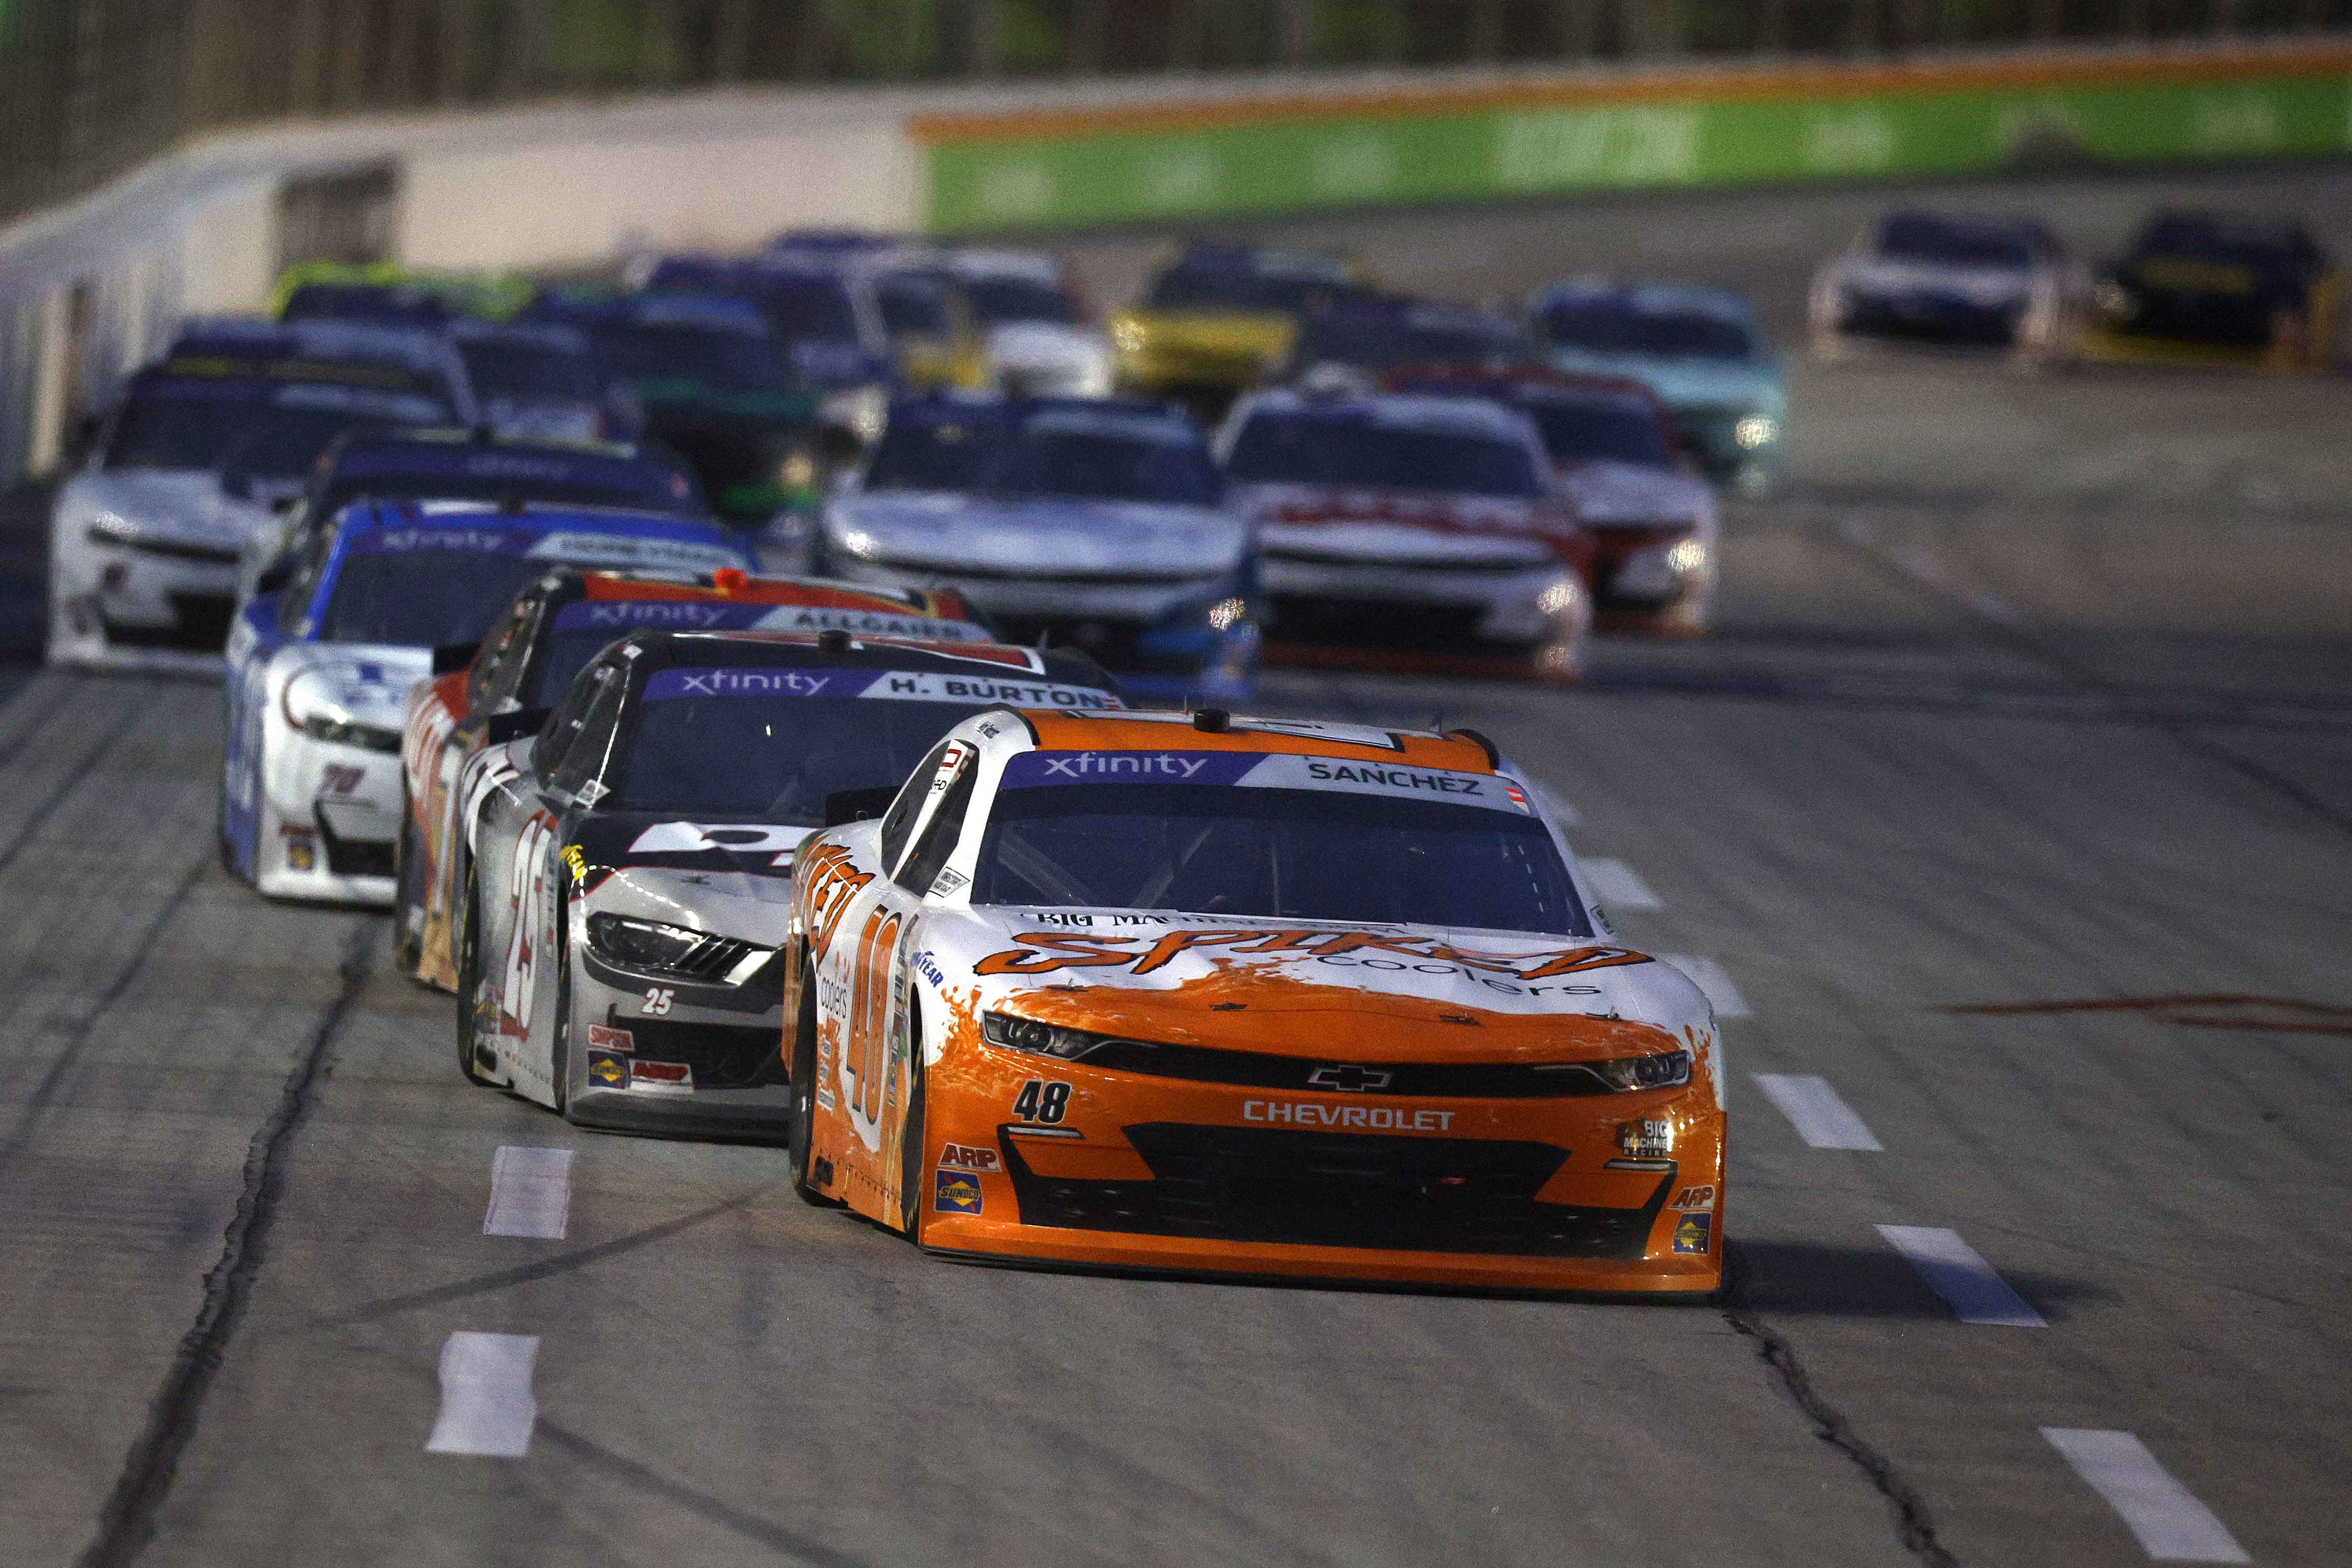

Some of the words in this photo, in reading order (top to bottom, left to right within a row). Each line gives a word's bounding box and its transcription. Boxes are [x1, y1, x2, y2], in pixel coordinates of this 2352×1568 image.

[589, 601, 729, 627] xfinity
[683, 670, 831, 696] xfinity
[889, 678, 930, 694] H.
[945, 681, 1104, 709] BURTON
[1046, 749, 1209, 779] xfinity
[1308, 761, 1485, 796] SANCHEZ
[1316, 956, 1602, 994] coolers
[642, 988, 673, 1015] 25
[1012, 1079, 1072, 1124] 48
[1243, 1101, 1455, 1131] CHEVROLET
[939, 1143, 997, 1168] ARP
[1624, 1137, 1669, 1149] MACHINE
[1672, 1186, 1714, 1207] ARP
